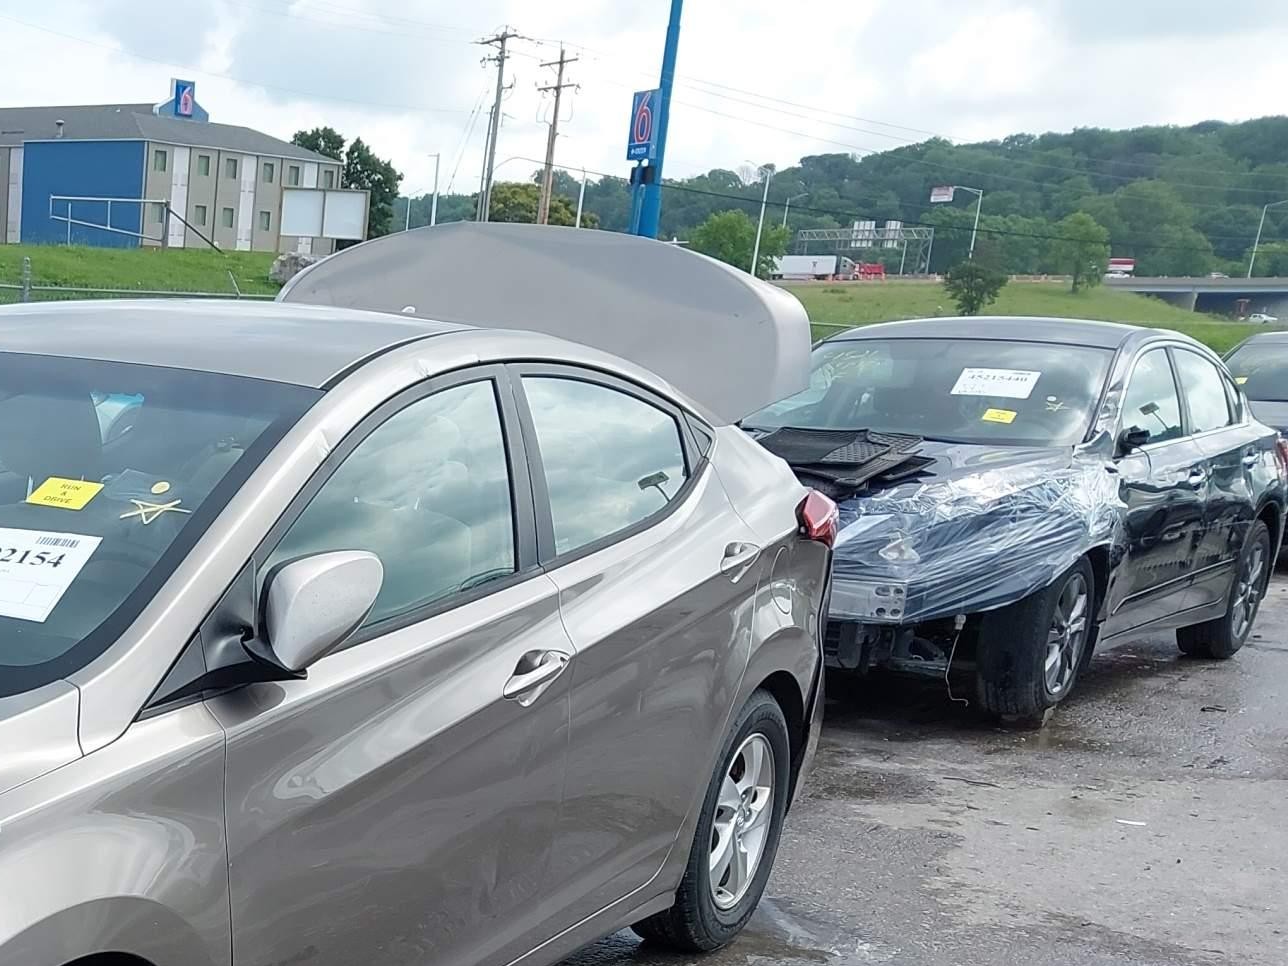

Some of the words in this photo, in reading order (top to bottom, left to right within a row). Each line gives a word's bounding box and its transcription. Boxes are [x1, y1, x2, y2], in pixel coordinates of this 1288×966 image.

[180, 86, 192, 115] 6
[634, 91, 652, 144] 6
[43, 495, 72, 504] DRIVE
